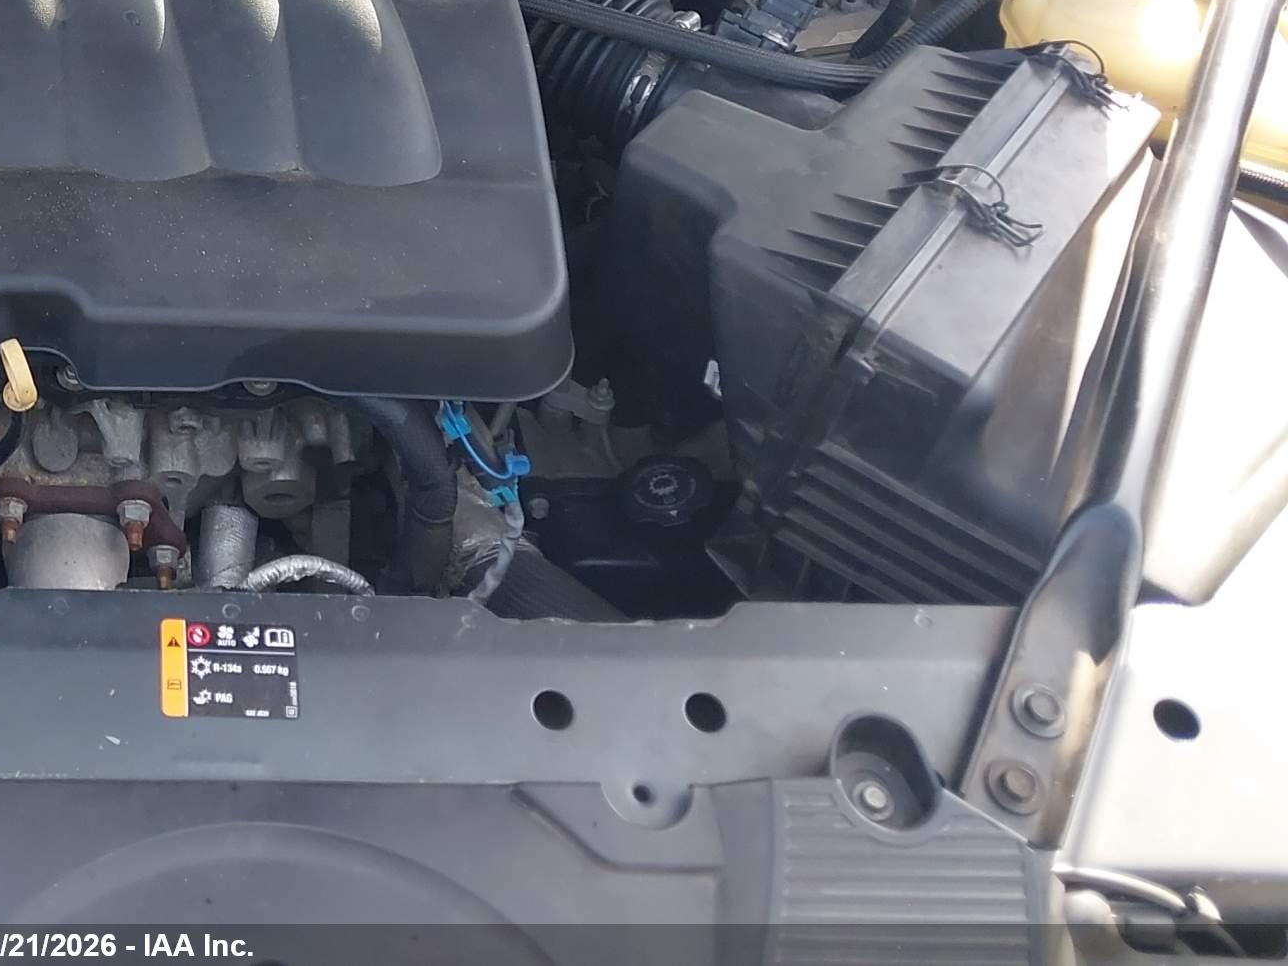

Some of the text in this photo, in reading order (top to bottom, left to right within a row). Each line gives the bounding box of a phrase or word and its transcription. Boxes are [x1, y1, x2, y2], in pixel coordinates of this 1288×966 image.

[217, 639, 237, 648] AUTO
[213, 662, 242, 674] R-134a
[277, 665, 289, 676] kg
[215, 692, 233, 704] PAG
